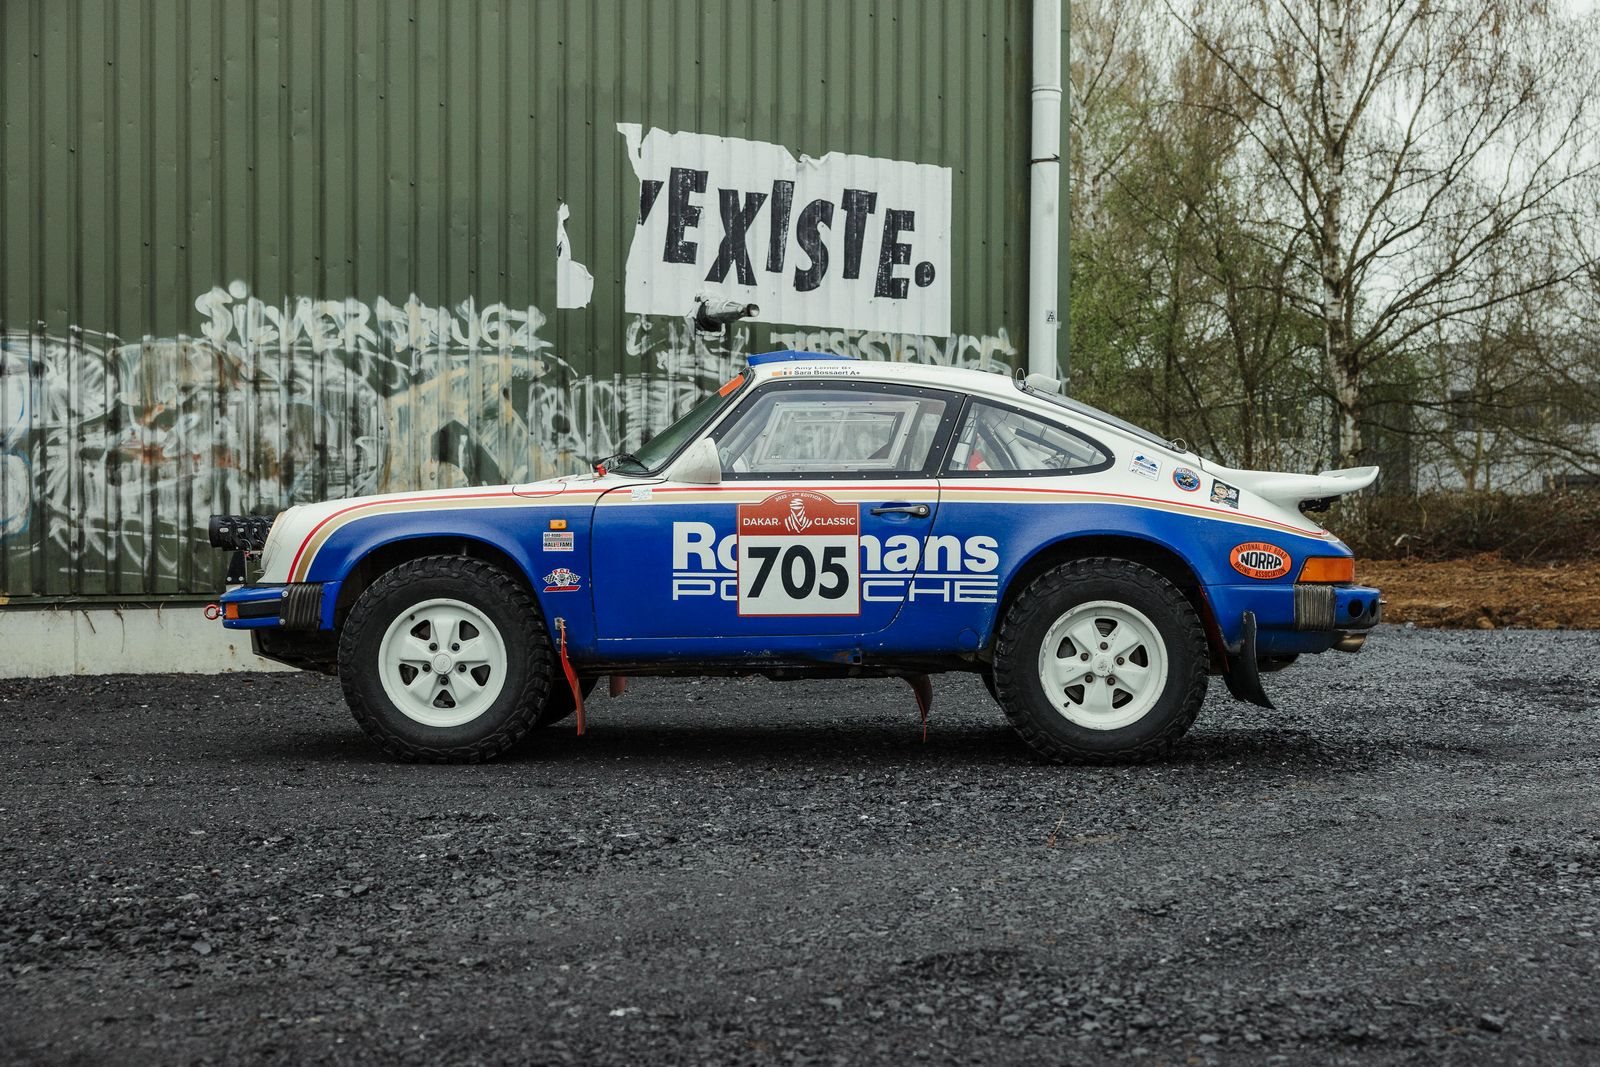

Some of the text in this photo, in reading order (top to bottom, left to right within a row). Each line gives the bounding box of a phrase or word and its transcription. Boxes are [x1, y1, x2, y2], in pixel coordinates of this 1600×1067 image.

[800, 492, 823, 502] EDITION
[743, 517, 856, 526] DAKAR CLASSIC
[1235, 543, 1288, 560] NATIONAL OFF ROAD
[1240, 551, 1283, 570] NORRA
[747, 544, 850, 600] 705
[1233, 561, 1287, 578] RACING ASSOCIATION
